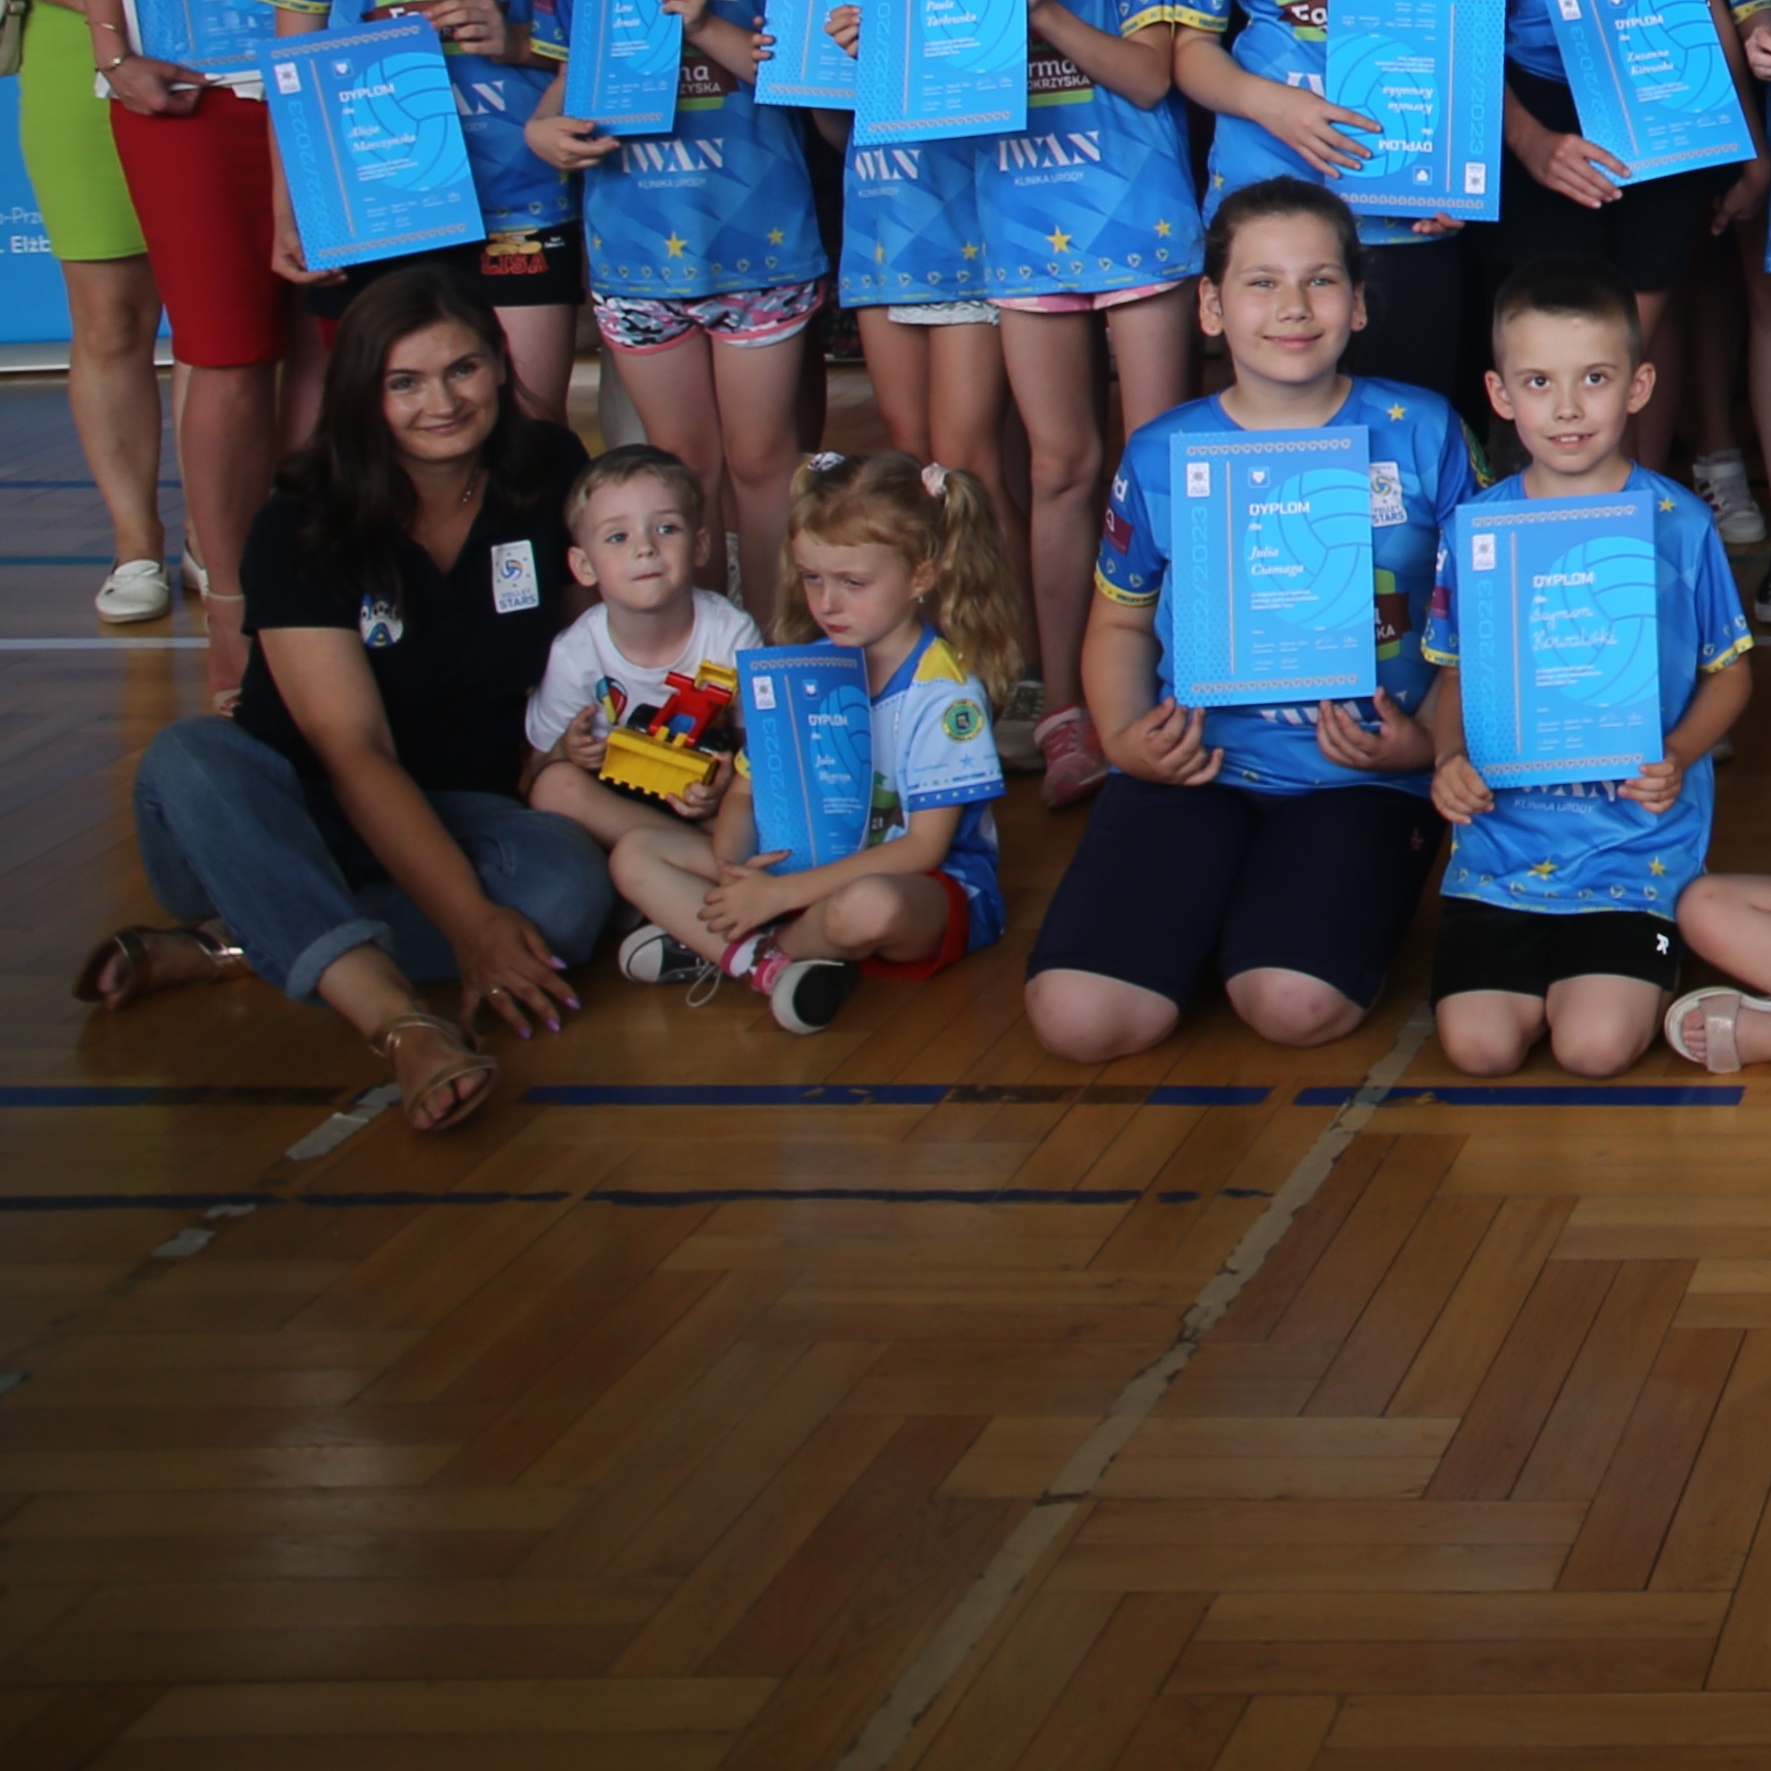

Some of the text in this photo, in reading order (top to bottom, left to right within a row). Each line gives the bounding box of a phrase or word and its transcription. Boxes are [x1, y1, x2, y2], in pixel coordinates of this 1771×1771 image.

[1614, 14, 1664, 30] DYPLOM
[338, 83, 396, 103] DYPLOM
[1378, 139, 1433, 153] DYPLOM
[1249, 501, 1311, 517] DYPLOM
[1372, 511, 1405, 524] STARS
[1532, 571, 1595, 589] DYPLOM
[498, 595, 537, 610] STARS
